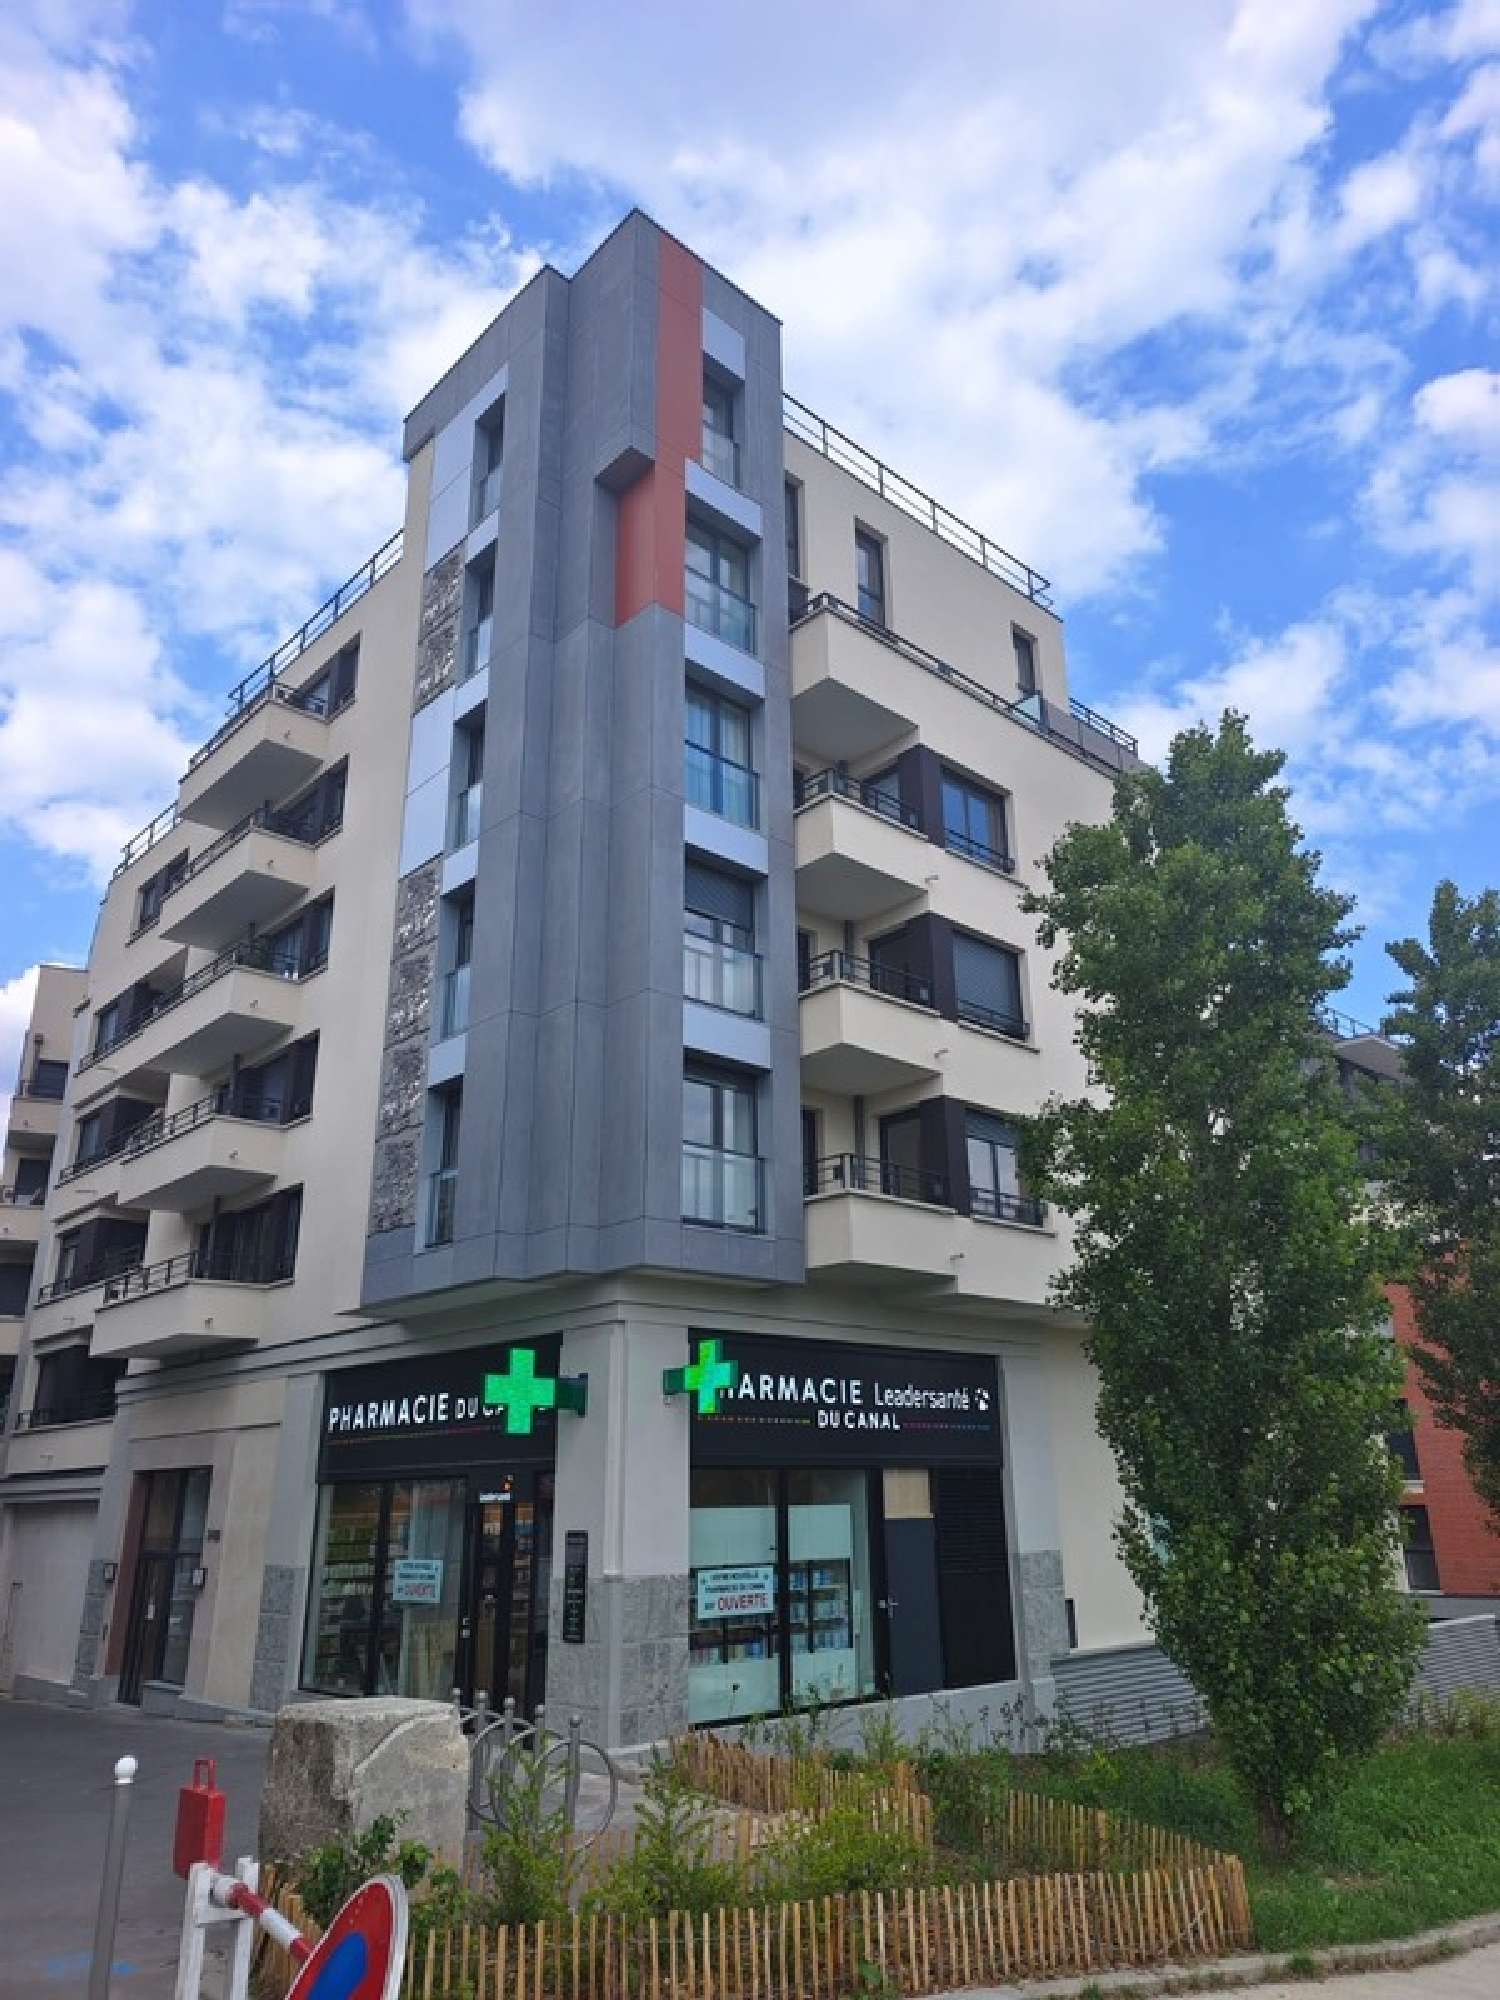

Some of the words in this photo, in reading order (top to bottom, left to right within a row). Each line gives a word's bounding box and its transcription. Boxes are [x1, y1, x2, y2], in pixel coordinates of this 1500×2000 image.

[719, 1373, 864, 1405] ARMACIE
[874, 1382, 969, 1411] Leadersanté
[328, 1392, 449, 1433] PHARMACIE
[455, 1396, 479, 1419] DU
[817, 1409, 840, 1429] DU
[844, 1410, 900, 1431] CANAL
